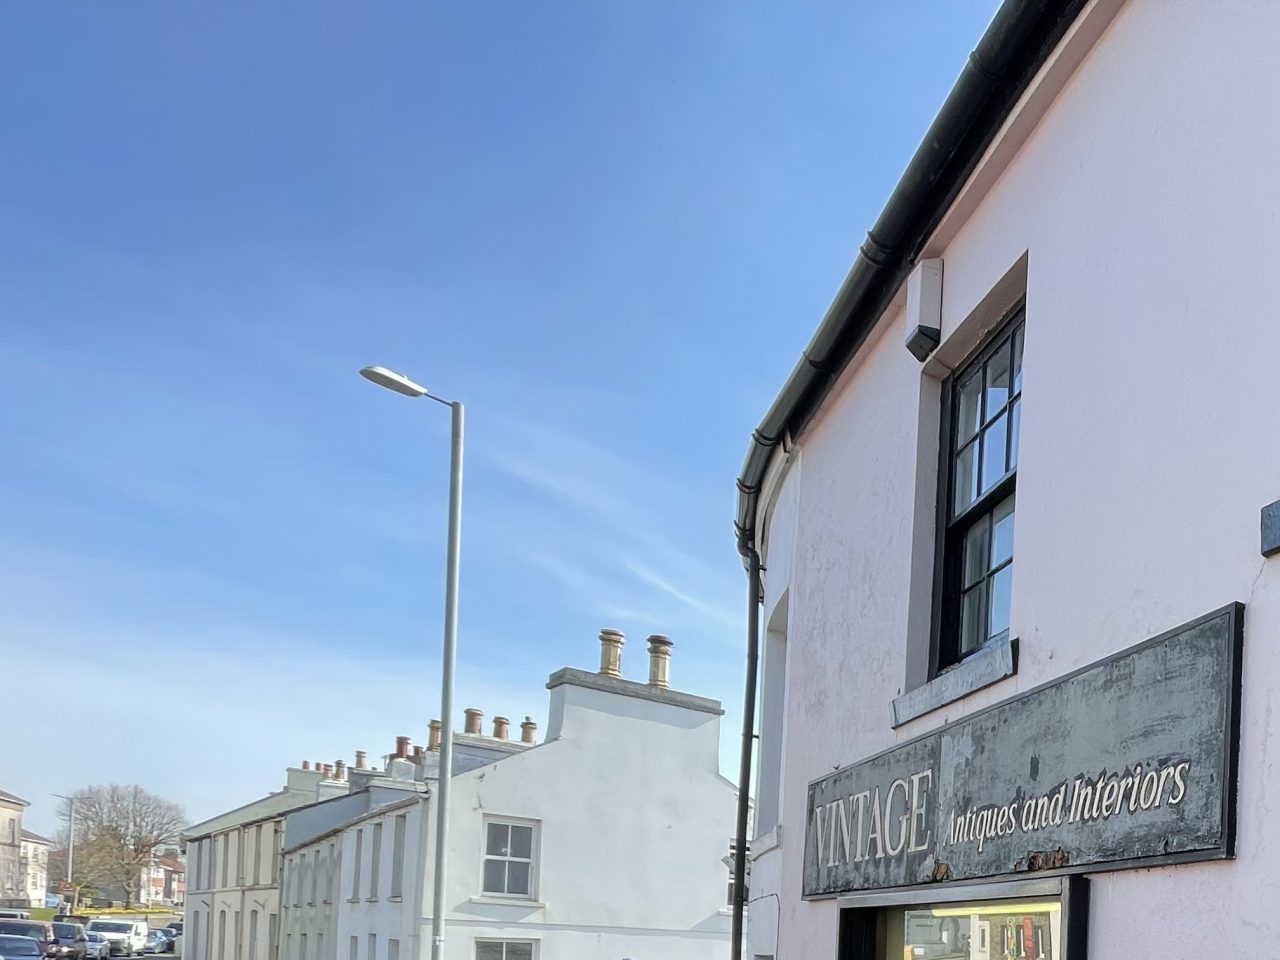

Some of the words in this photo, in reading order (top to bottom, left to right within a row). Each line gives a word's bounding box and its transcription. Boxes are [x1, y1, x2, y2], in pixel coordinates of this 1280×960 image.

[816, 769, 932, 868] VINTAGE
[943, 802, 1017, 852] Antiques
[1021, 781, 1066, 831] and
[1067, 761, 1191, 823] Interiors
